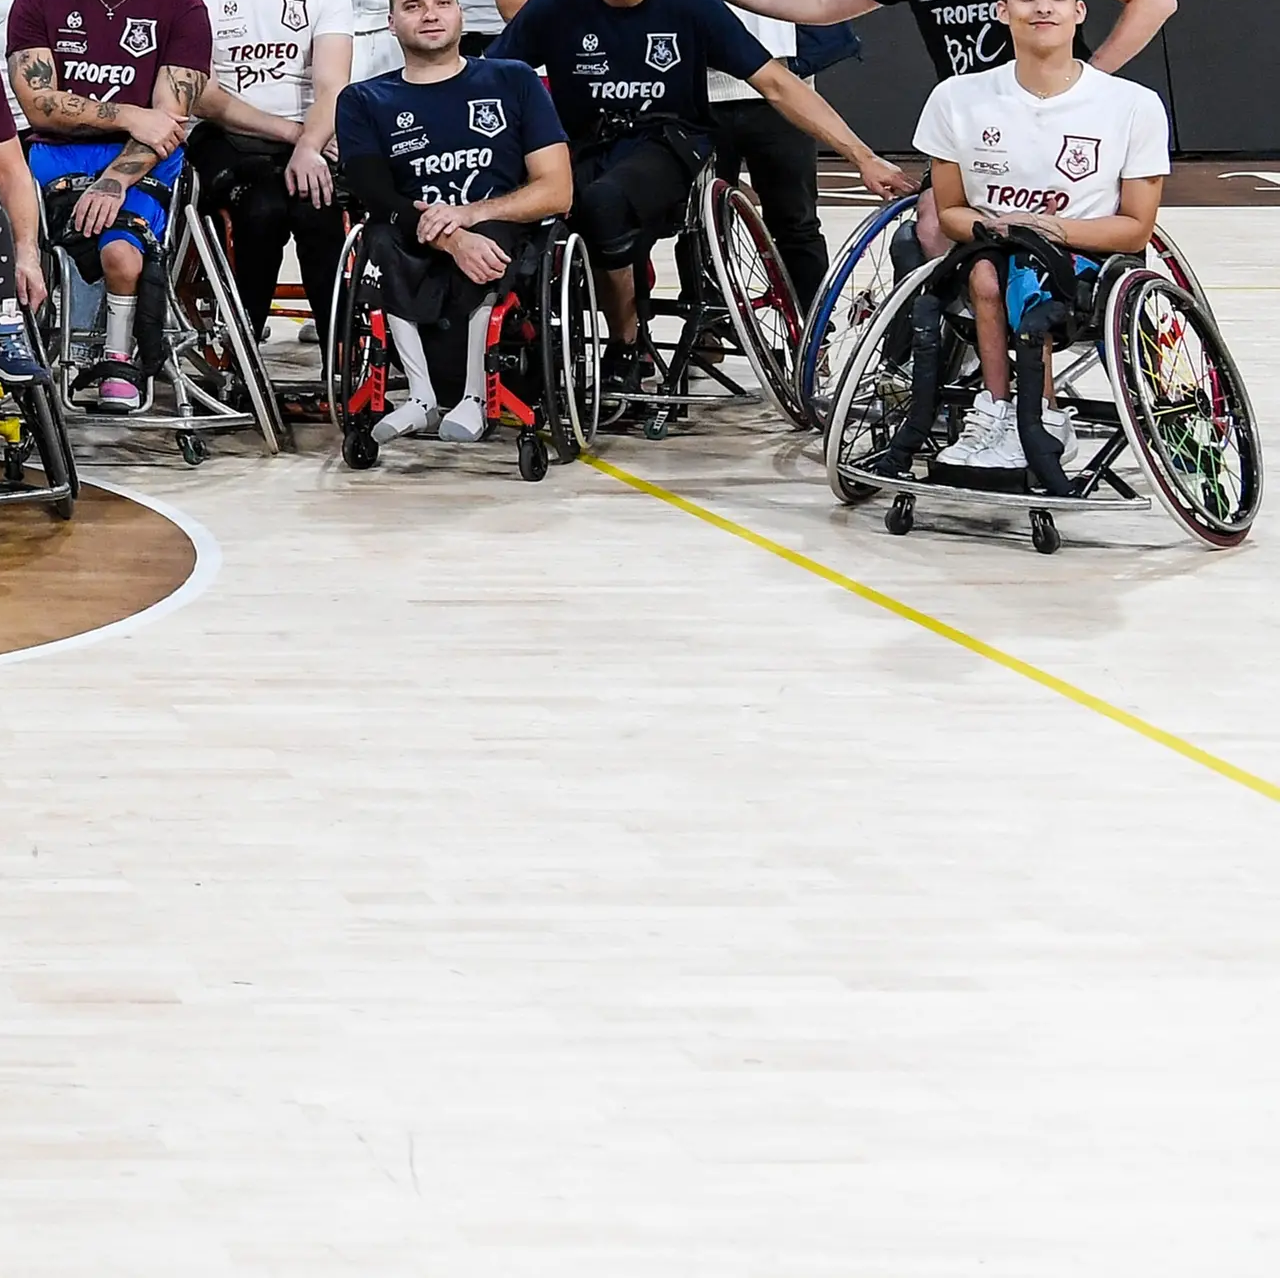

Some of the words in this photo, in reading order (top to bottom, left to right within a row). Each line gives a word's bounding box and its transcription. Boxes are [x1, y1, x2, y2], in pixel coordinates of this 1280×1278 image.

[228, 43, 298, 62] TROFEO
[64, 61, 136, 85] TROFEO
[588, 81, 666, 99] TROFEO
[409, 148, 493, 176] TROFEO
